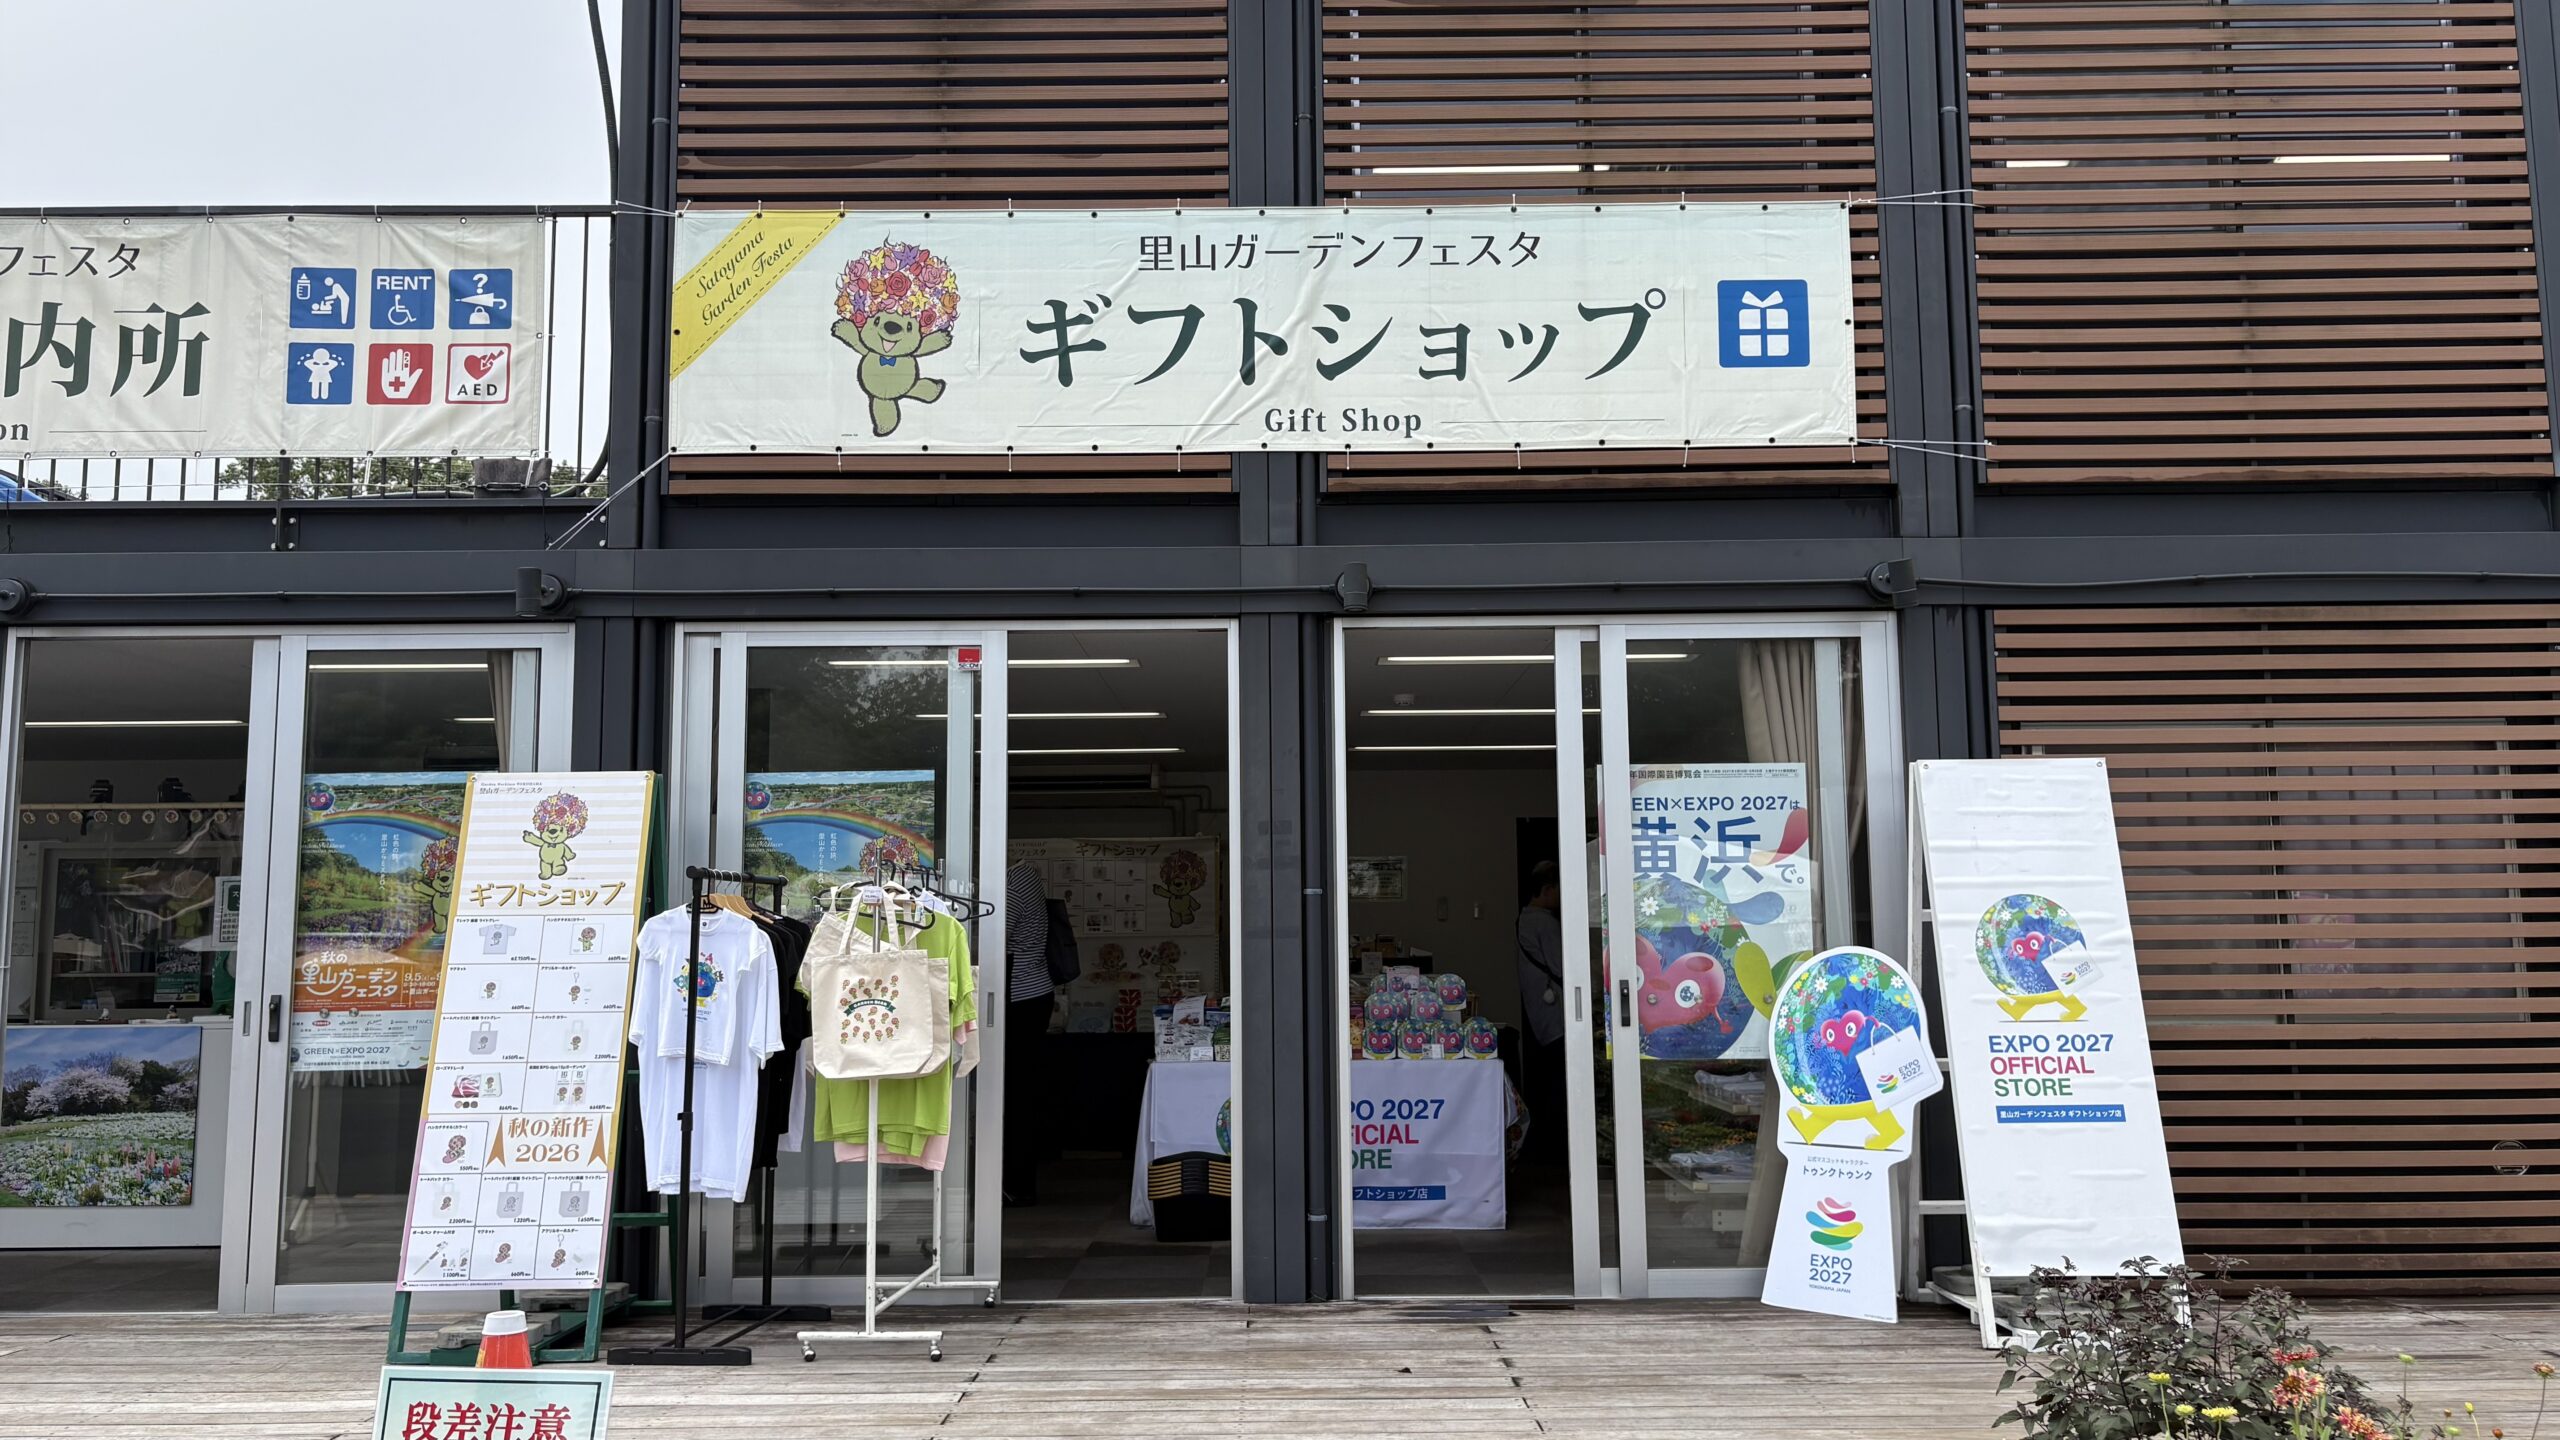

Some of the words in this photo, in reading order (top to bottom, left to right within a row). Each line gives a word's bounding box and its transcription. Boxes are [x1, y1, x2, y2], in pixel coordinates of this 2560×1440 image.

[0, 243, 140, 278] フェスタ
[1139, 231, 1542, 272] 里山ガーデンフェスタ
[697, 231, 764, 298] Satoyama
[376, 276, 432, 292] RENT
[702, 276, 752, 326] Garden
[751, 236, 795, 278] Festa
[1020, 287, 1667, 388] ギフトショップ
[3, 301, 210, 398] 内所
[457, 384, 498, 397] AED
[1264, 408, 1327, 433] Gift
[1342, 407, 1422, 440] Shop
[470, 881, 626, 906] ギフトショップ
[320, 951, 347, 964] 秋の
[1988, 1034, 2050, 1053] EXPO
[2056, 1034, 2114, 1052] 2027
[1899, 1059, 1919, 1073] EXPO
[1901, 1065, 1921, 1080] 2027
[1990, 1056, 2095, 1075] OFFICIAL
[1994, 1078, 2073, 1097] STORE
[1382, 1099, 1445, 1120] 2027
[2000, 1110, 2066, 1119] 里山ガーデンフェスタ
[2068, 1109, 2121, 1118] ギフトショップ店
[508, 1116, 594, 1139] 秋の新作
[515, 1144, 579, 1162] 2026
[1803, 1165, 1872, 1180] トゥンクトゥンク
[1810, 1254, 1852, 1270] EXPO
[1809, 1268, 1852, 1285] 2027
[402, 1401, 572, 1440] 段差注意
